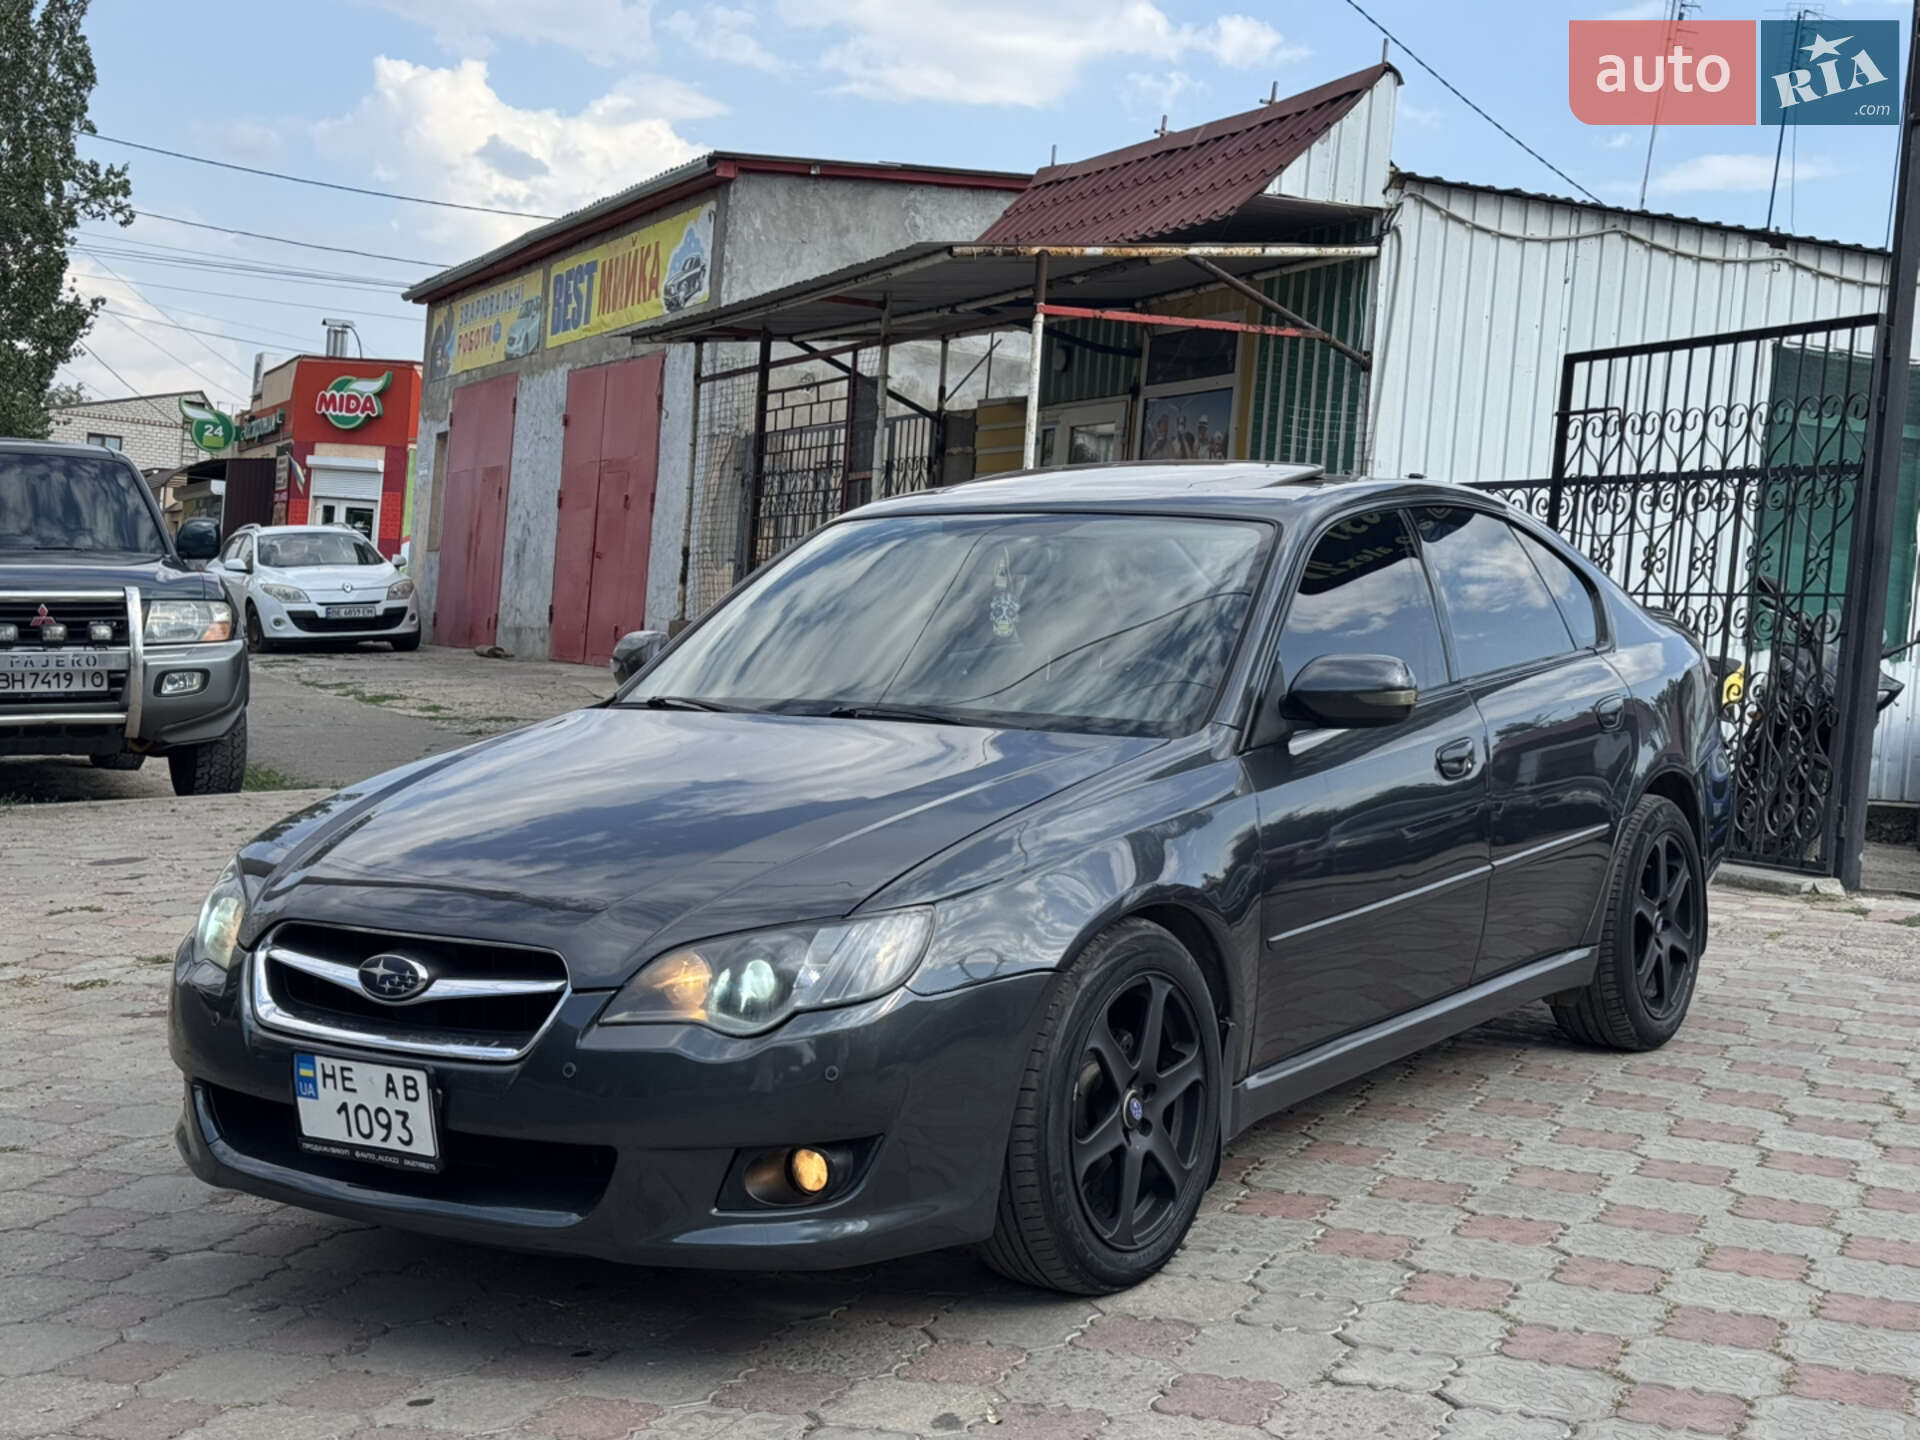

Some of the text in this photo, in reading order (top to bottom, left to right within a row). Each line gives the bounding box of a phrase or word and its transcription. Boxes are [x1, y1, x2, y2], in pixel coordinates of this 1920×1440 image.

[551, 236, 661, 336] BEST МИЙКА
[316, 391, 378, 417] MIDA
[204, 423, 225, 437] 24
[10, 655, 98, 668] PAJERO
[29, 671, 74, 690] 7419
[82, 671, 104, 689] IO
[300, 1081, 316, 1097] UA
[320, 1062, 420, 1103] HE AB
[336, 1101, 414, 1147] 1093
